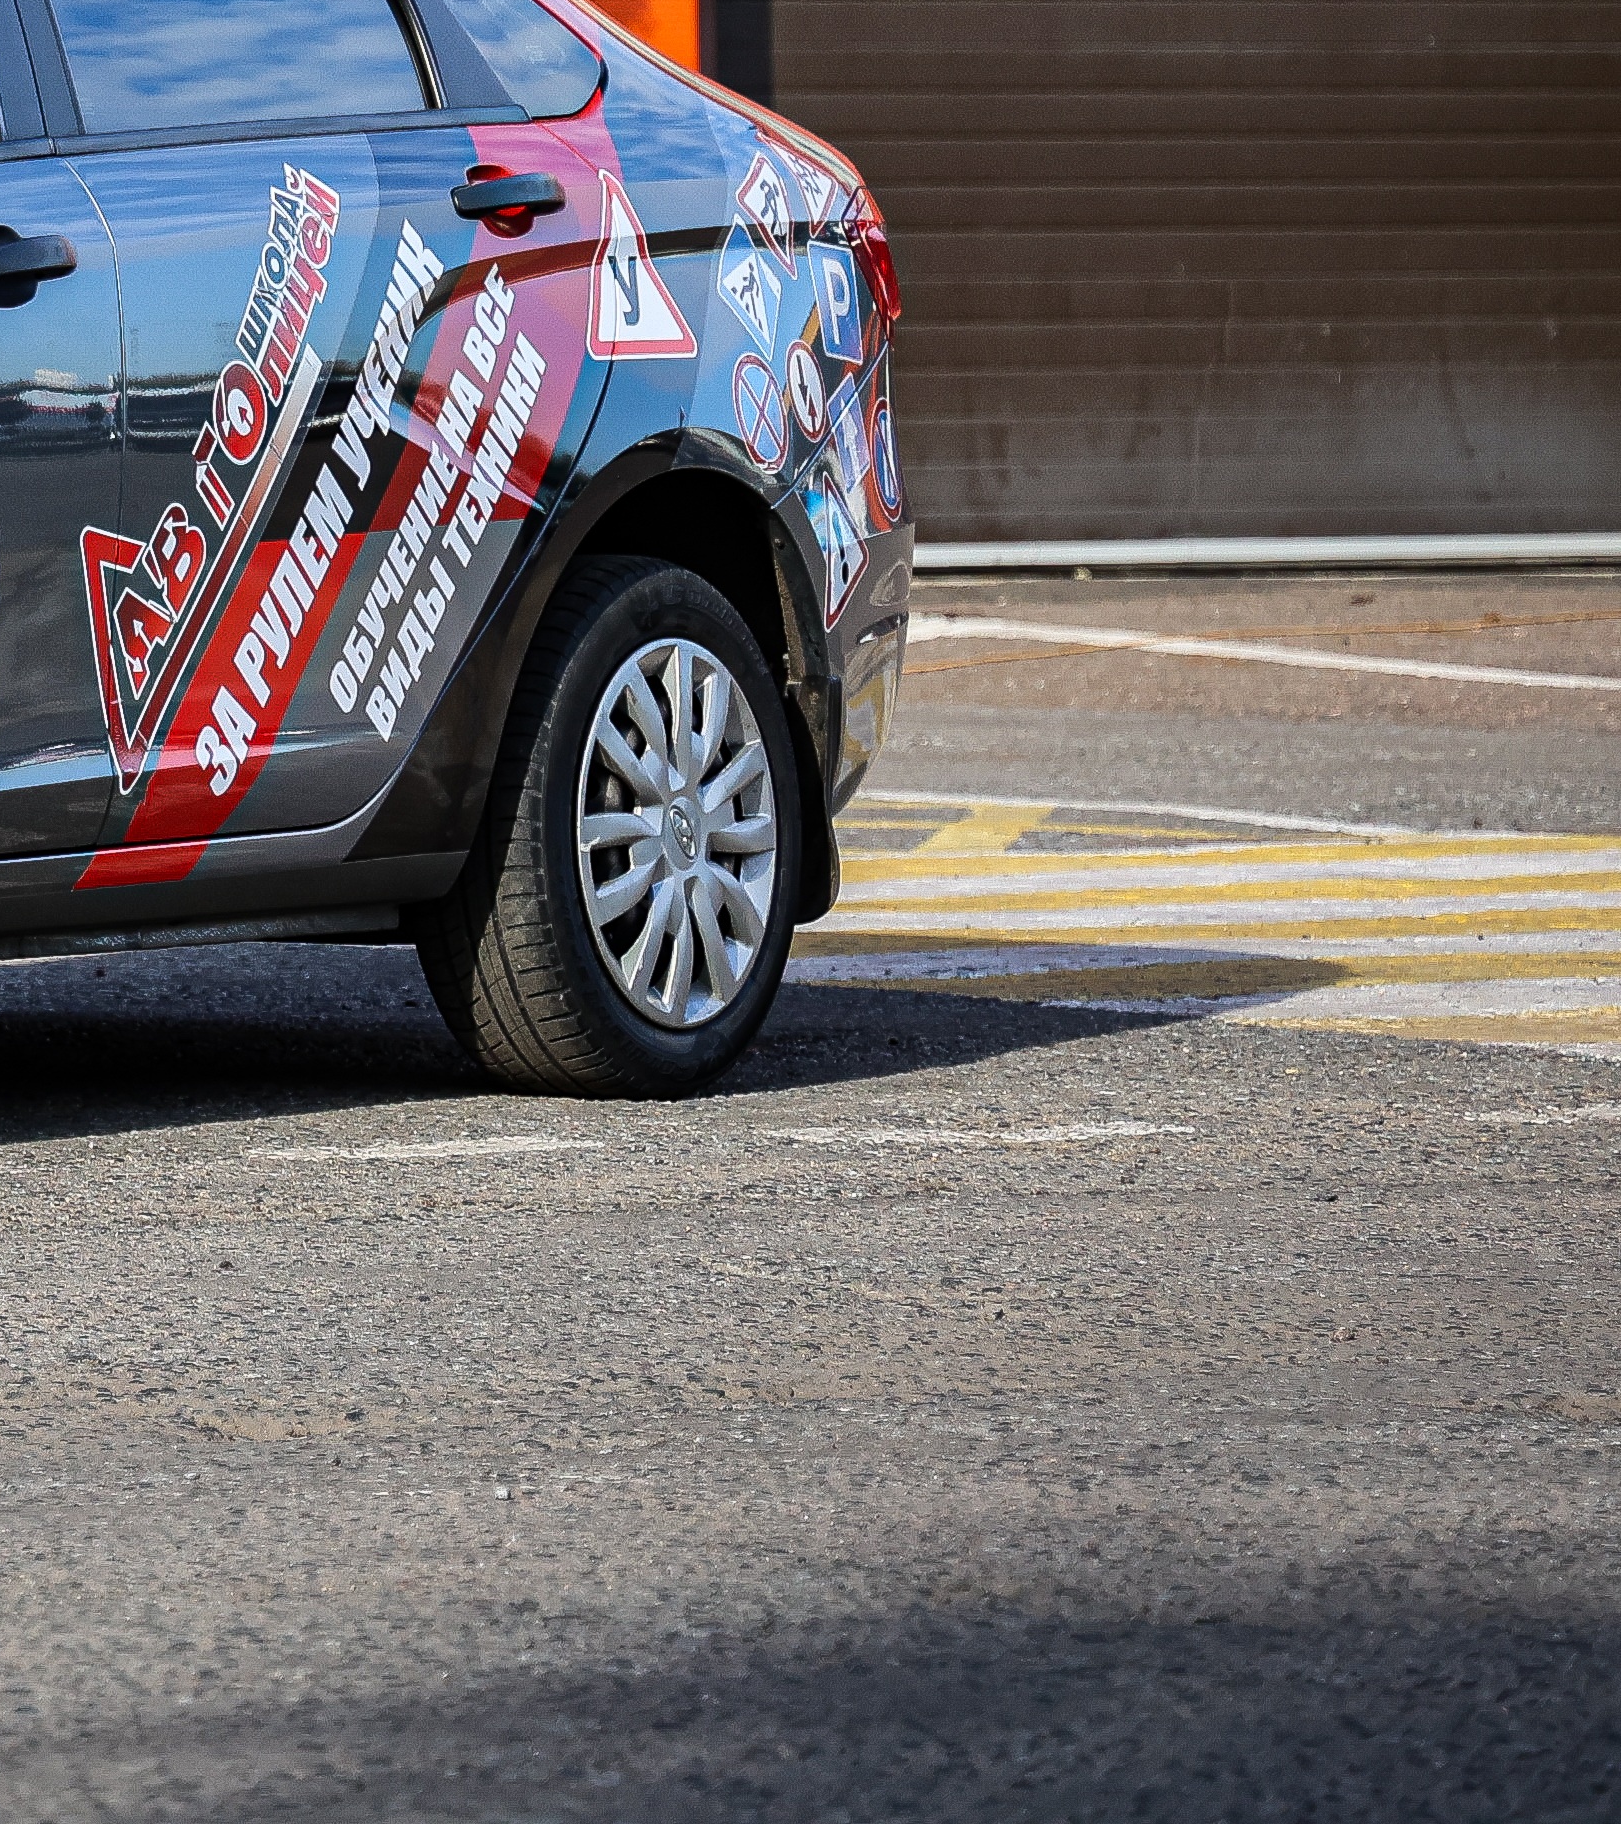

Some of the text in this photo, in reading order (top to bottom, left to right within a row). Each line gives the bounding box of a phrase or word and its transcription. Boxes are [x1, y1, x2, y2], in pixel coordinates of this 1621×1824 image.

[235, 186, 303, 367] ШКОЛА
[329, 262, 516, 714] ОБУЧЕНИЕ НА ВСЕ
[195, 217, 445, 797] ЗА РУЛЕМ УЧЕНИК
[365, 330, 548, 743] ВИДЫ ТЕХНИКИ
